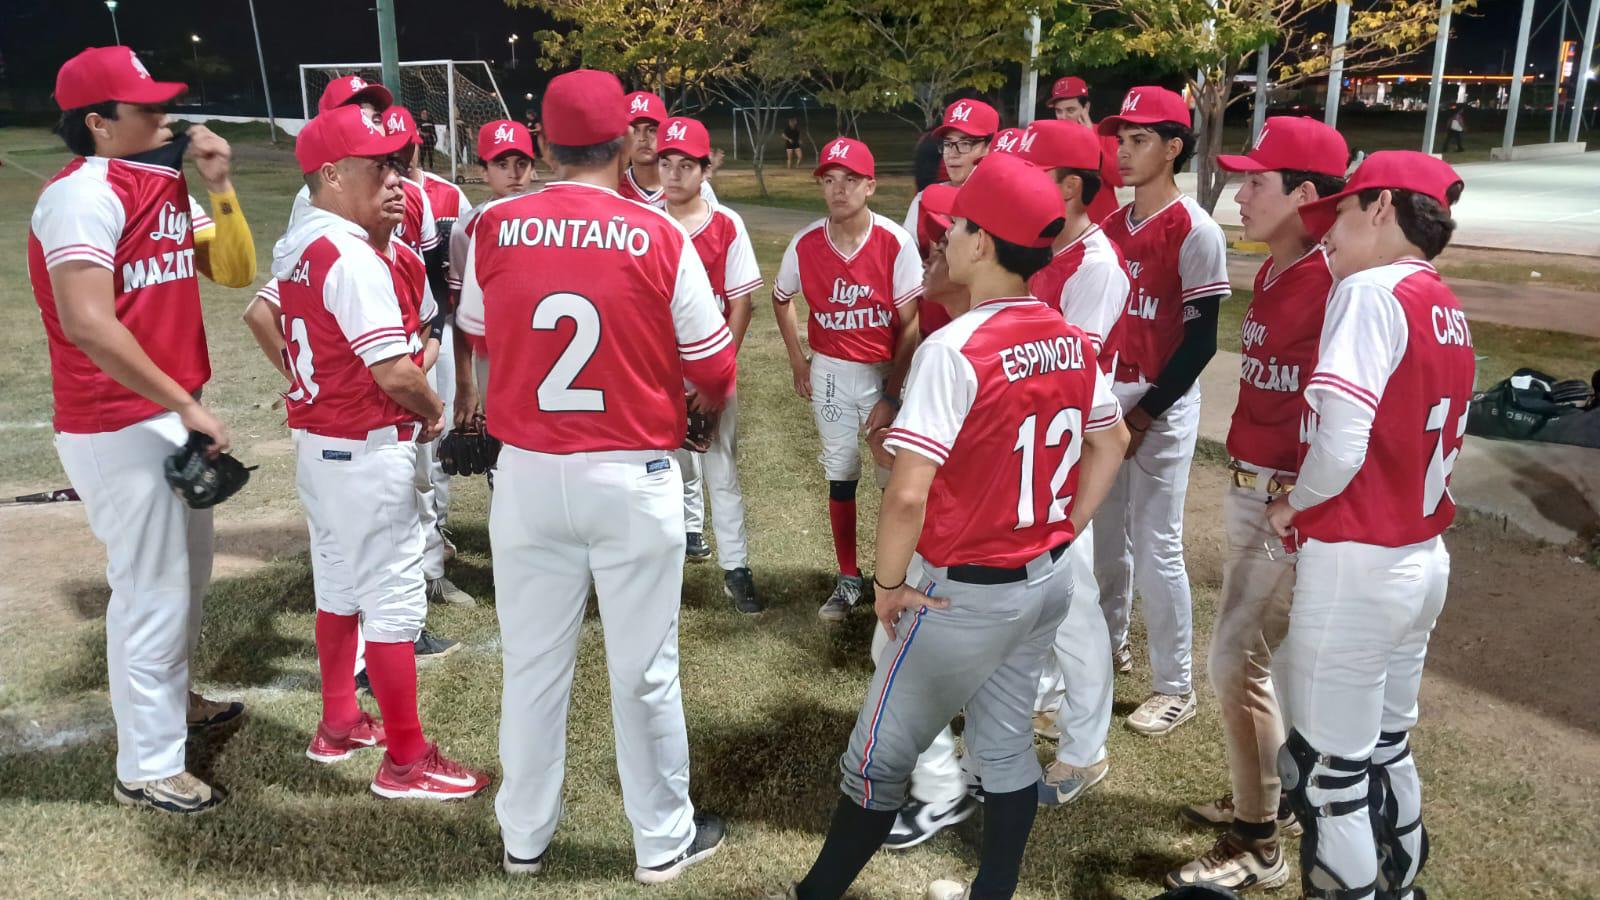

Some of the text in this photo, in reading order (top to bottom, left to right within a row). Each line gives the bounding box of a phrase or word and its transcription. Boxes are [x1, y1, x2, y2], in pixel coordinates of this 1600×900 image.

[496, 216, 650, 257] MONTAÑO
[828, 277, 874, 307] Liga
[1431, 304, 1474, 348] CAST
[531, 291, 606, 414] 2
[998, 336, 1087, 384] ESPINOZA
[1009, 407, 1083, 532] 12
